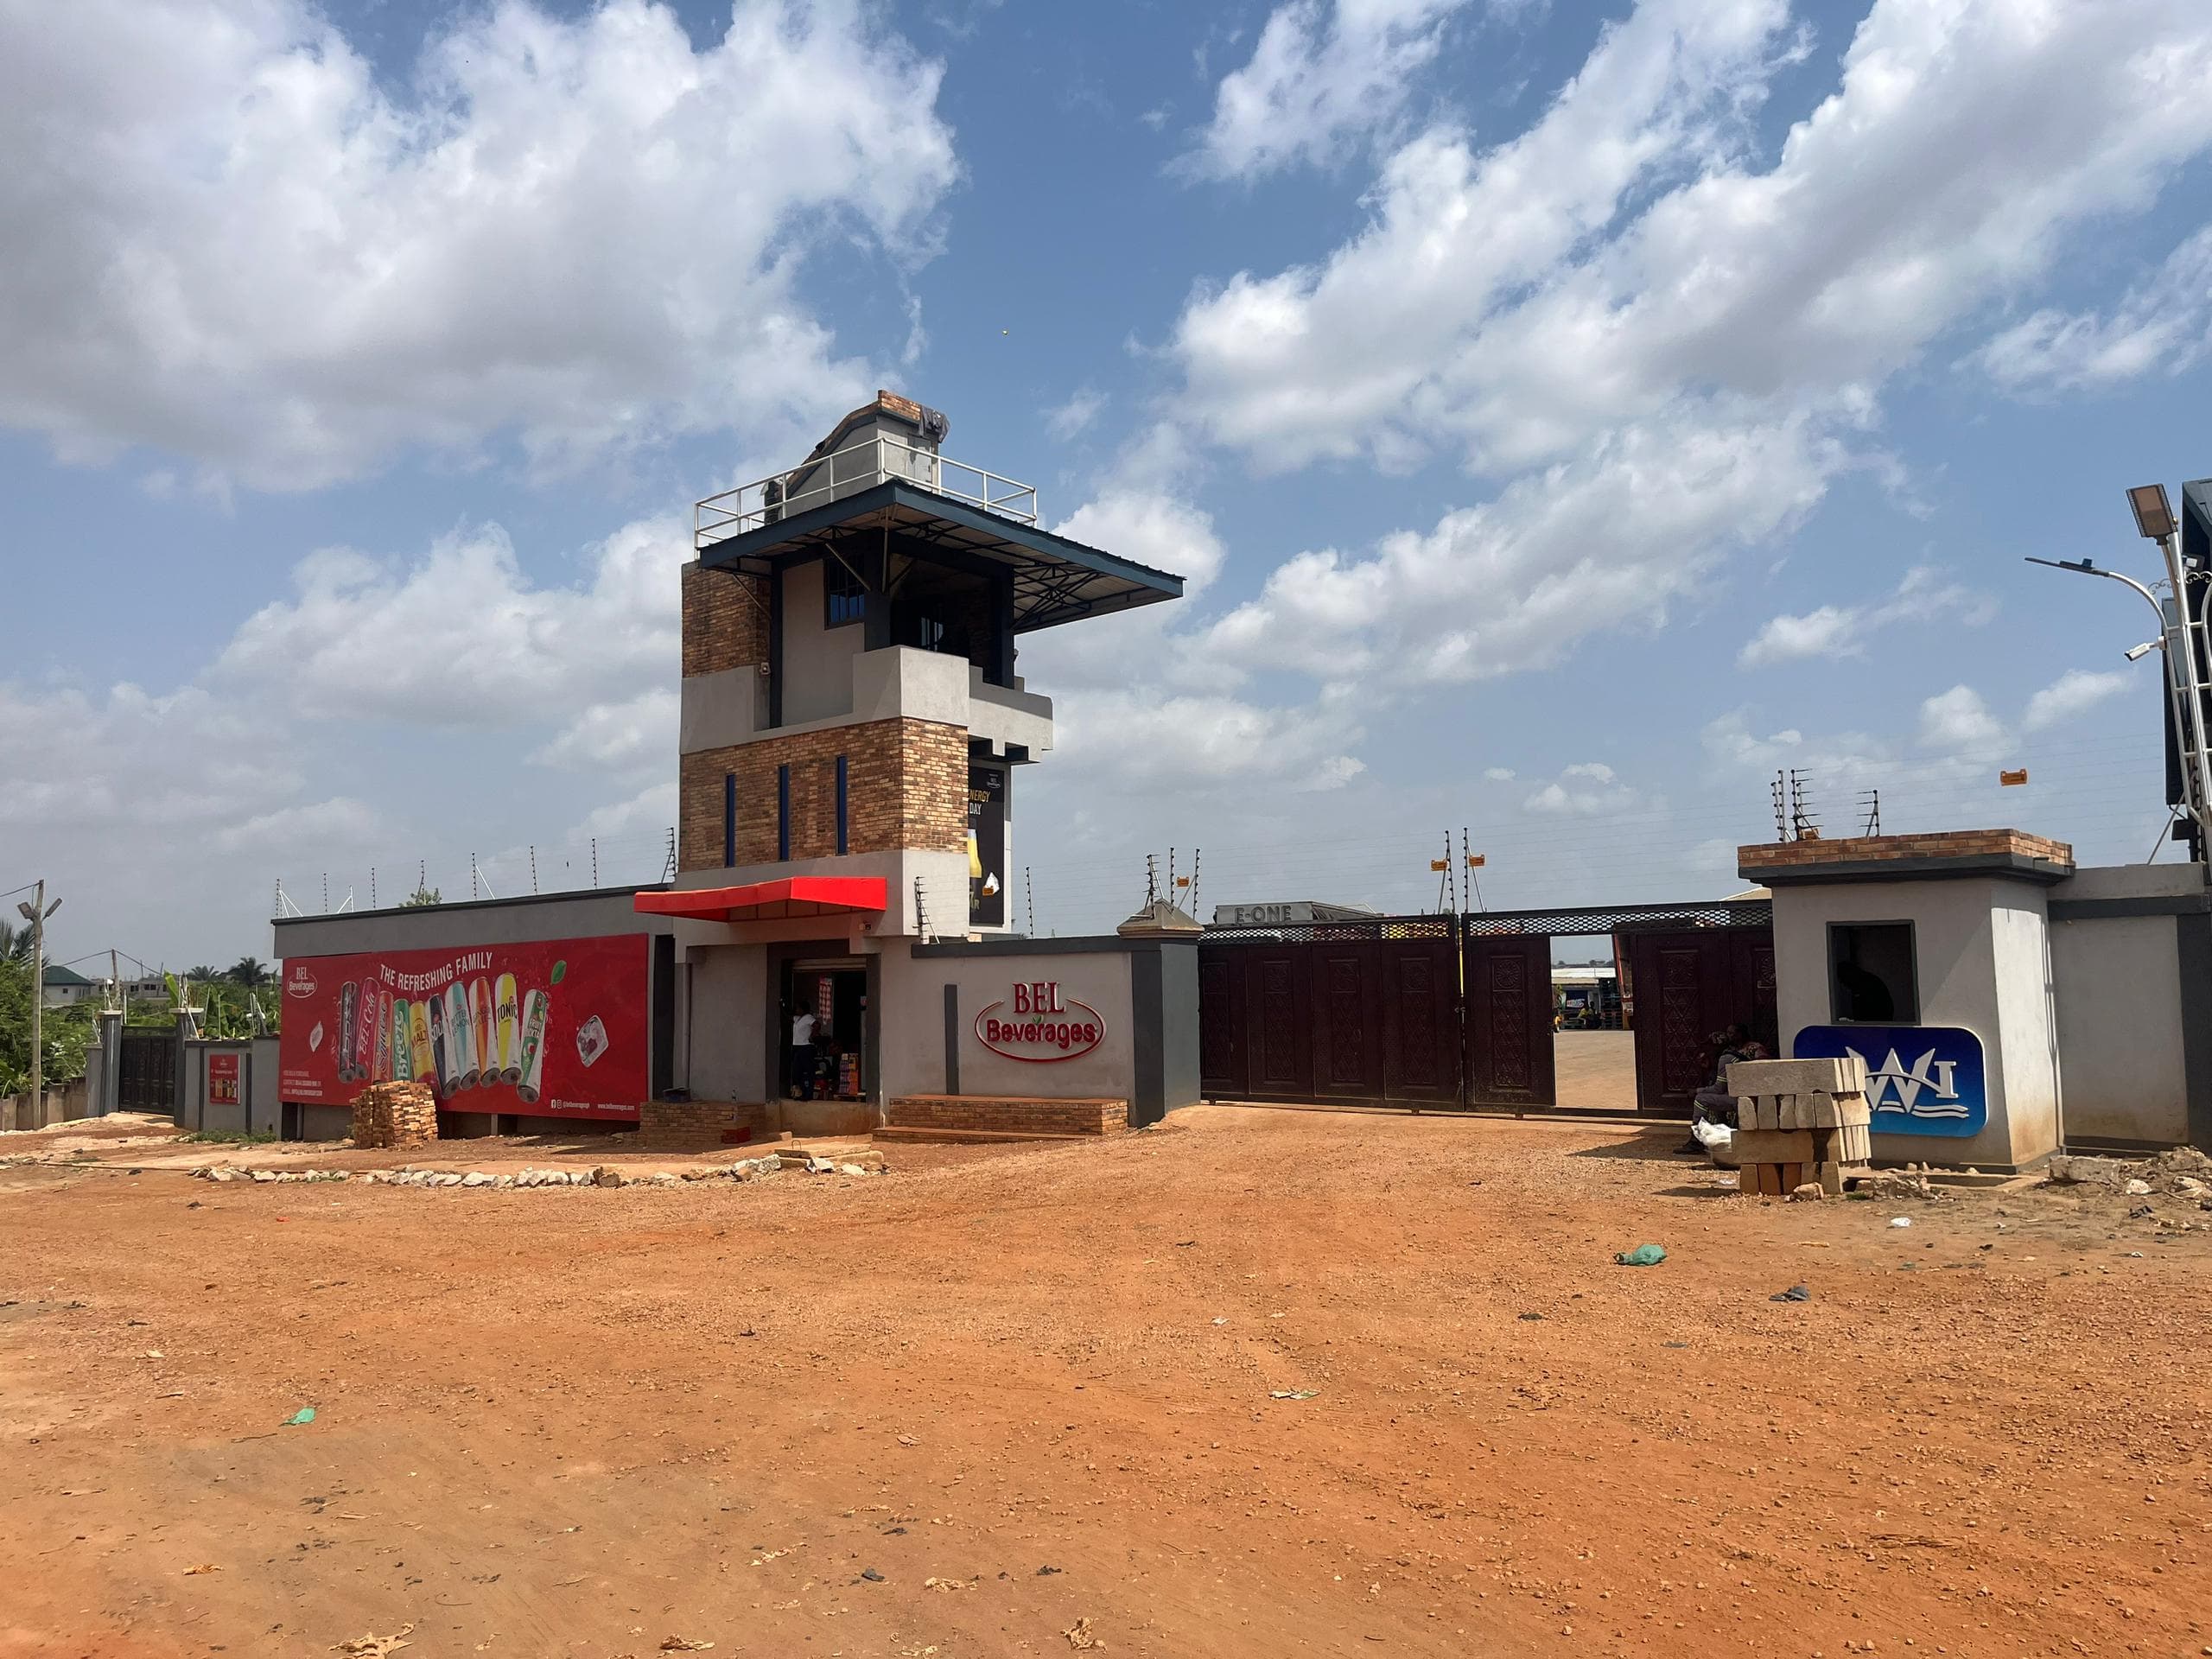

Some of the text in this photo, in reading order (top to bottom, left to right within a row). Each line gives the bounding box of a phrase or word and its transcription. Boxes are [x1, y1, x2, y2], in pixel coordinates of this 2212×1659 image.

[968, 788, 991, 803] NERGY
[969, 802, 982, 815] DAY
[1234, 906, 1292, 925] E-ONE
[296, 967, 308, 980] BEL
[380, 951, 493, 991] THE REFRESHING FAMILY
[289, 981, 315, 993] Beverages
[1013, 982, 1066, 1014] BEL
[394, 1010, 409, 1078] Breeze
[986, 1019, 1097, 1050] Beverages
